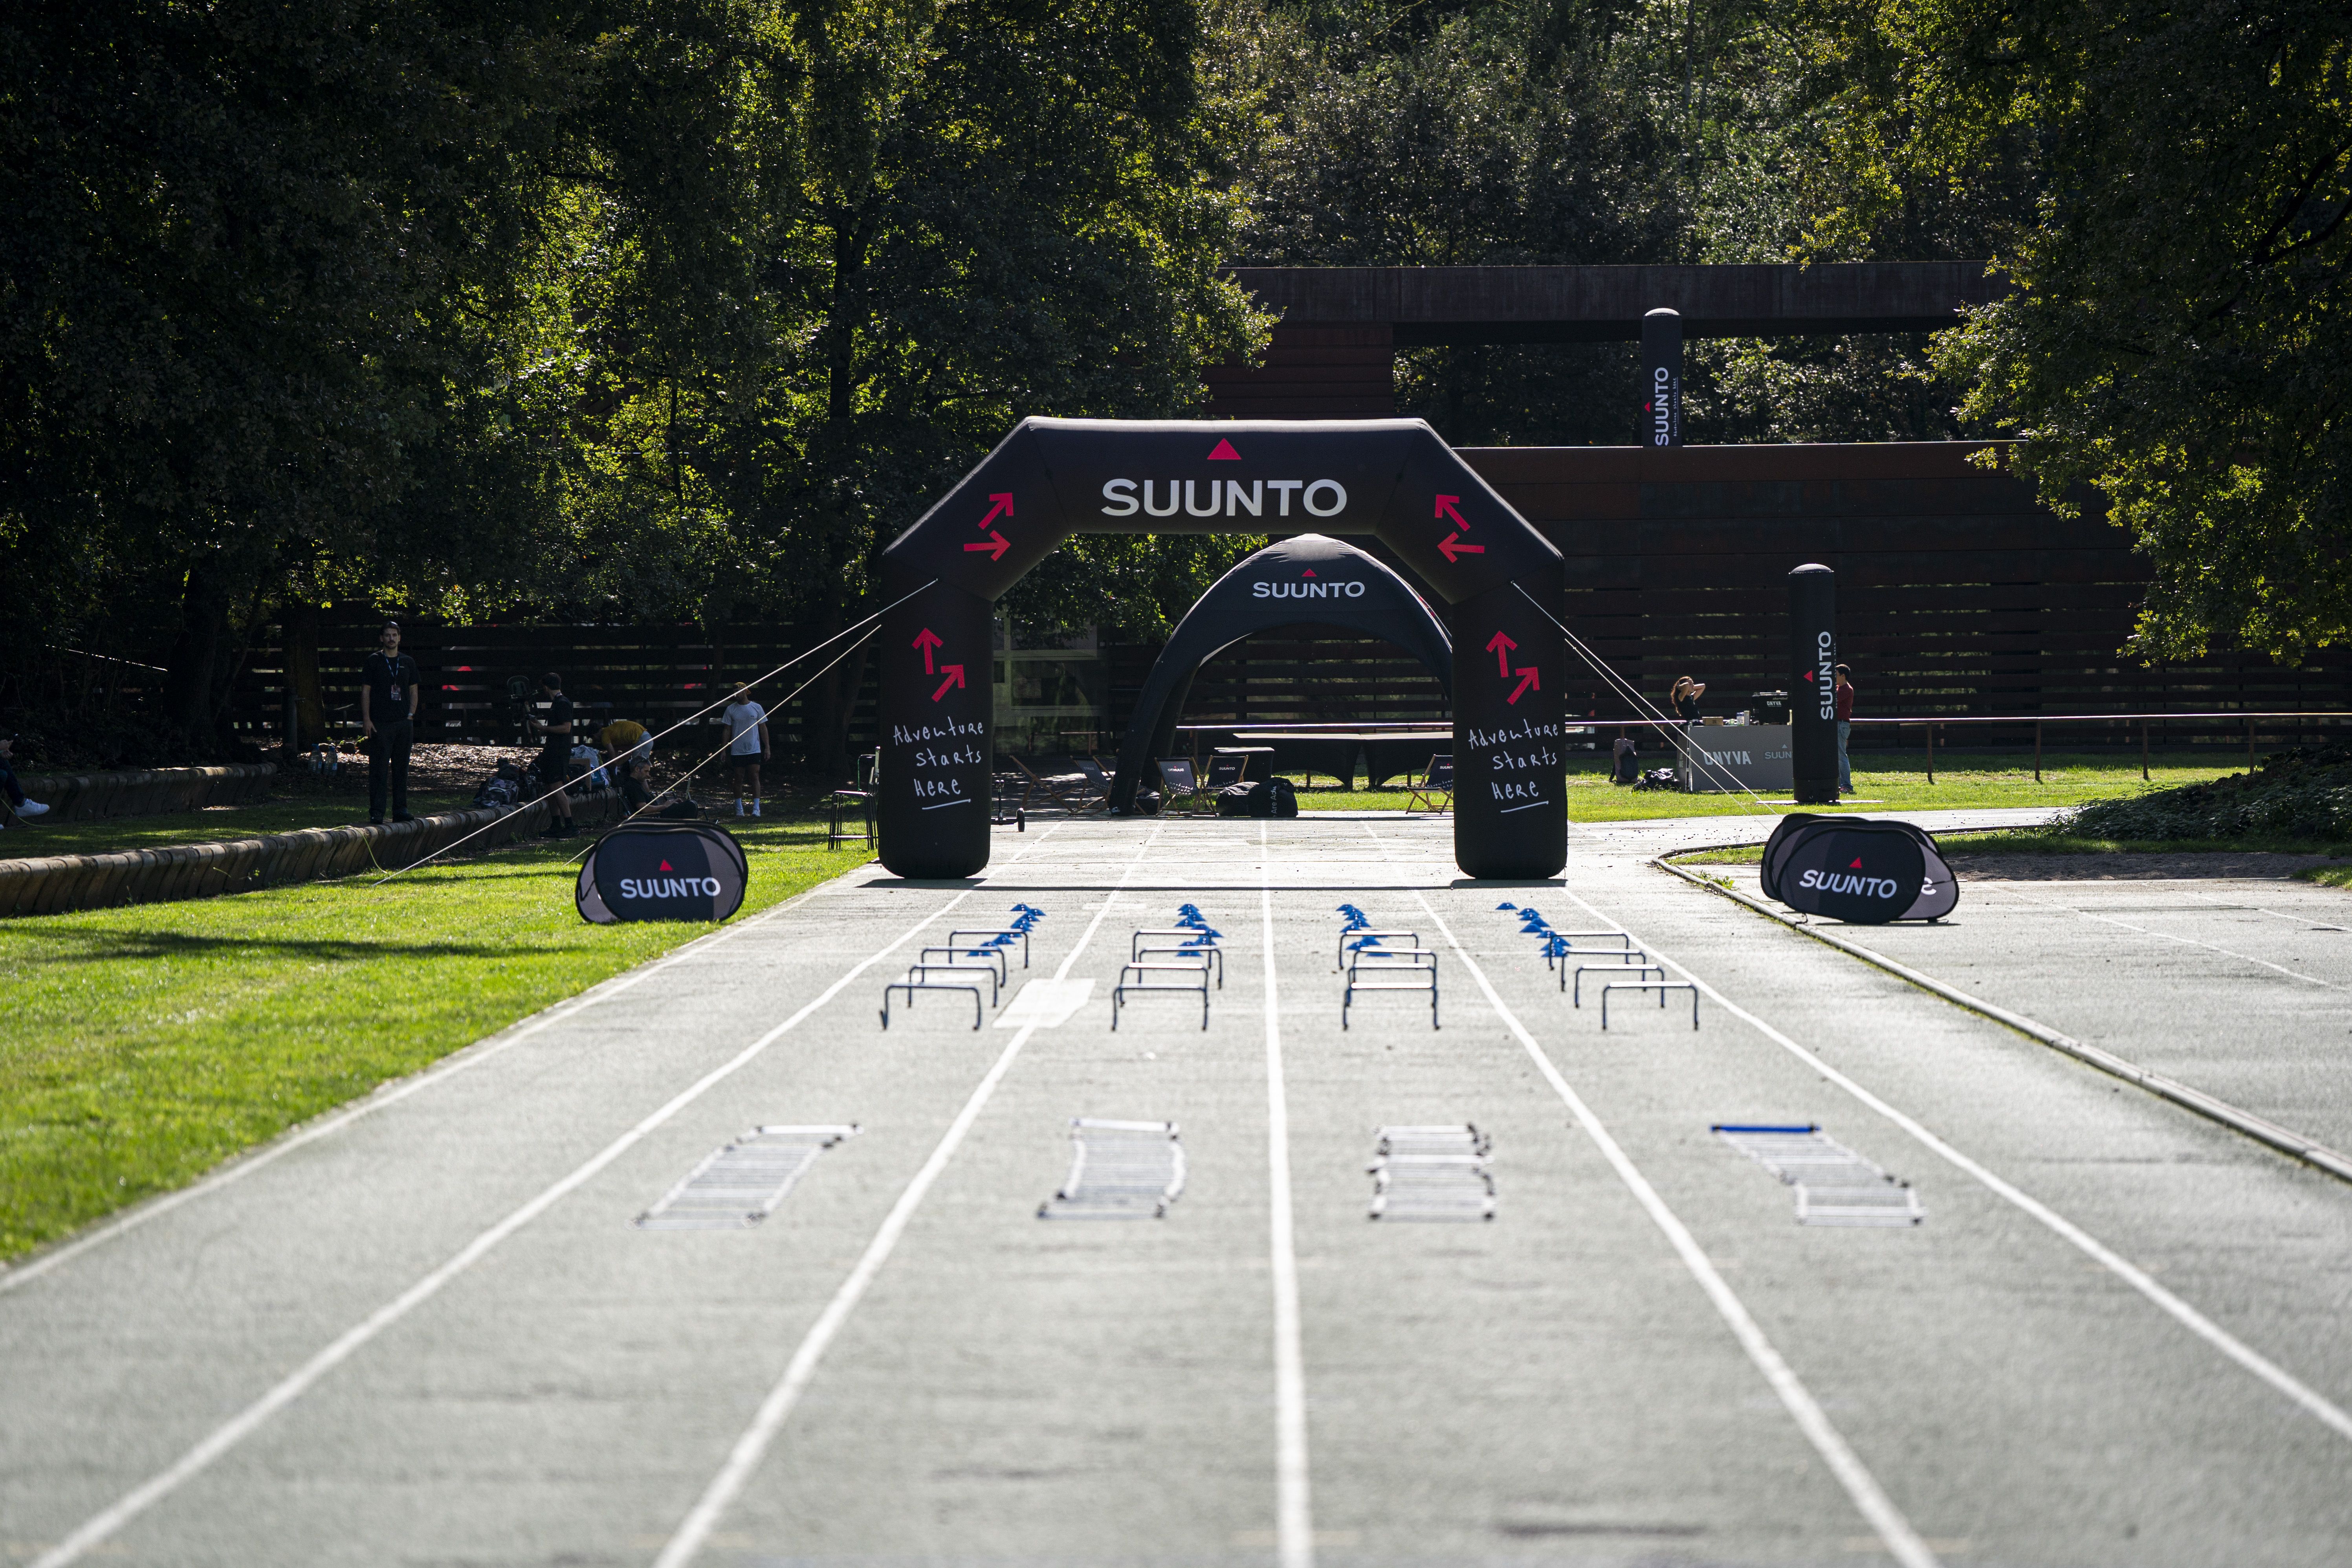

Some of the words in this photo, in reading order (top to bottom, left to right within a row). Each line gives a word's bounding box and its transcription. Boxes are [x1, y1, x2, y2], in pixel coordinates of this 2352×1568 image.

[1655, 367, 1669, 446] SUUNTO
[1101, 478, 1347, 517] SUUNTO
[1252, 581, 1365, 598] SUUNTO
[1818, 631, 1834, 720] SUUNTO
[1703, 751, 1752, 765] ONYVA
[1764, 751, 1792, 759] SUUN
[620, 877, 721, 899] SUUNTO
[1799, 869, 1897, 899] SUUNTO
